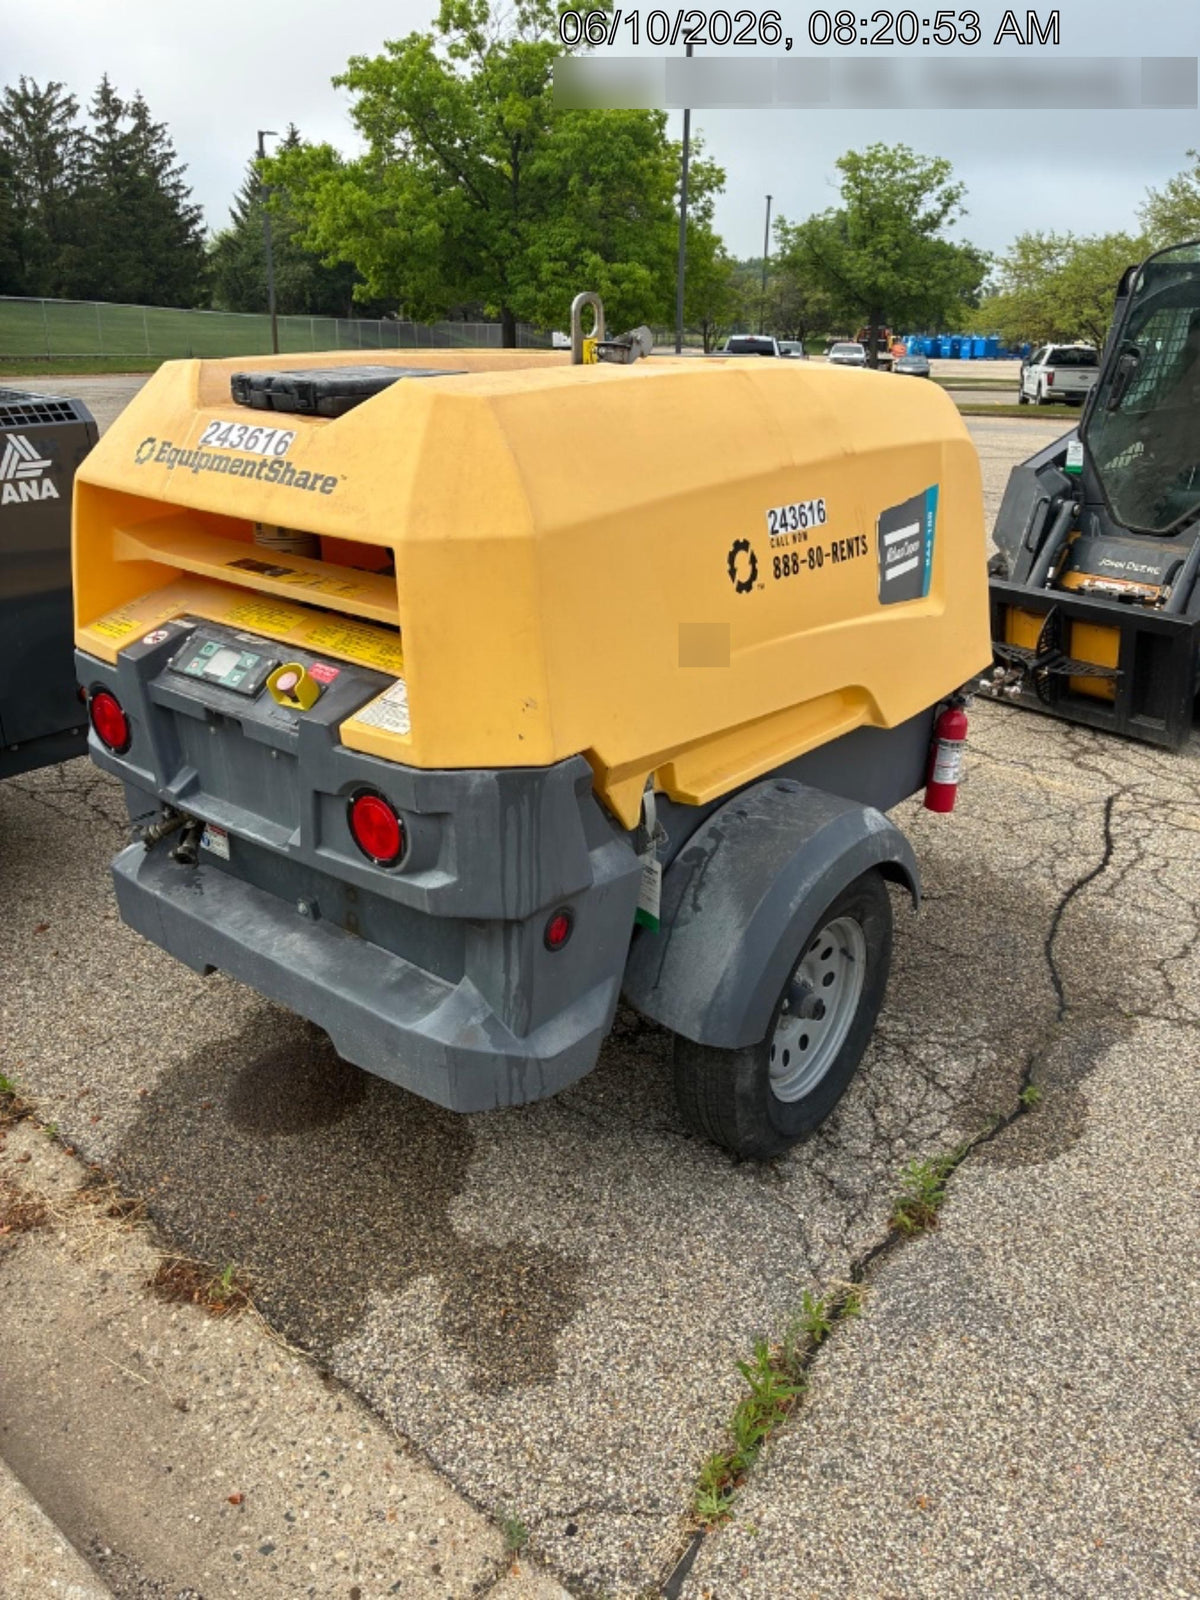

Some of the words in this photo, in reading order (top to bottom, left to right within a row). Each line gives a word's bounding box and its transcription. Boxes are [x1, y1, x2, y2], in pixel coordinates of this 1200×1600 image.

[201, 421, 294, 456] 243616
[154, 440, 339, 495] EquipmentShare
[1, 478, 60, 505] ANA
[768, 499, 826, 536] 243616
[770, 535, 789, 549] CALL
[792, 531, 808, 544] NOW
[773, 534, 868, 580] 888-80-RENTS
[1099, 558, 1124, 570] JOHN
